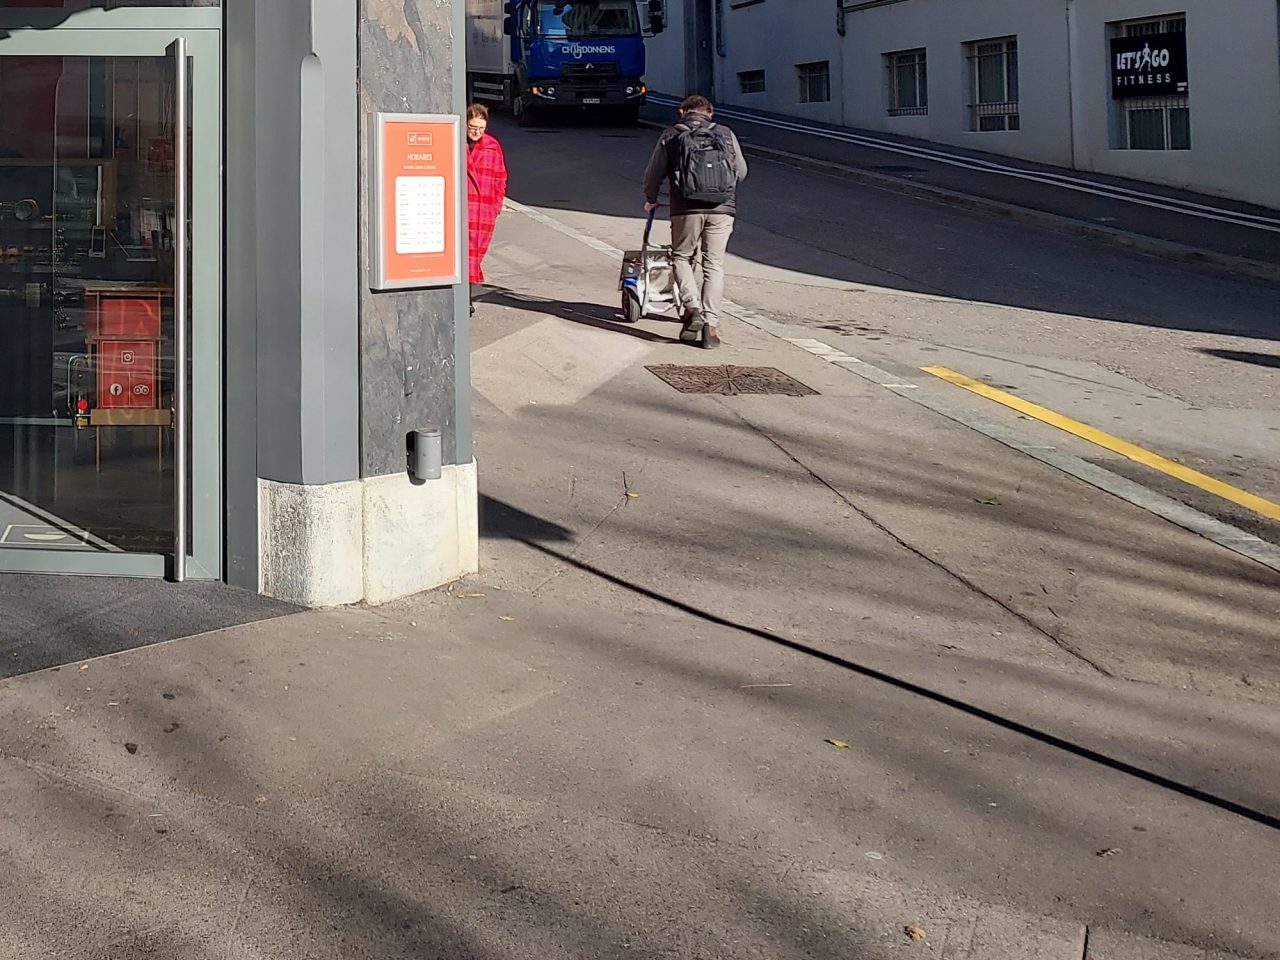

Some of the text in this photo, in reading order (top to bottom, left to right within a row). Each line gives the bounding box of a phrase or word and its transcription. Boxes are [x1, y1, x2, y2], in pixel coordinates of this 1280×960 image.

[1116, 48, 1169, 69] LET'S GO
[1117, 73, 1170, 86] FITNESS
